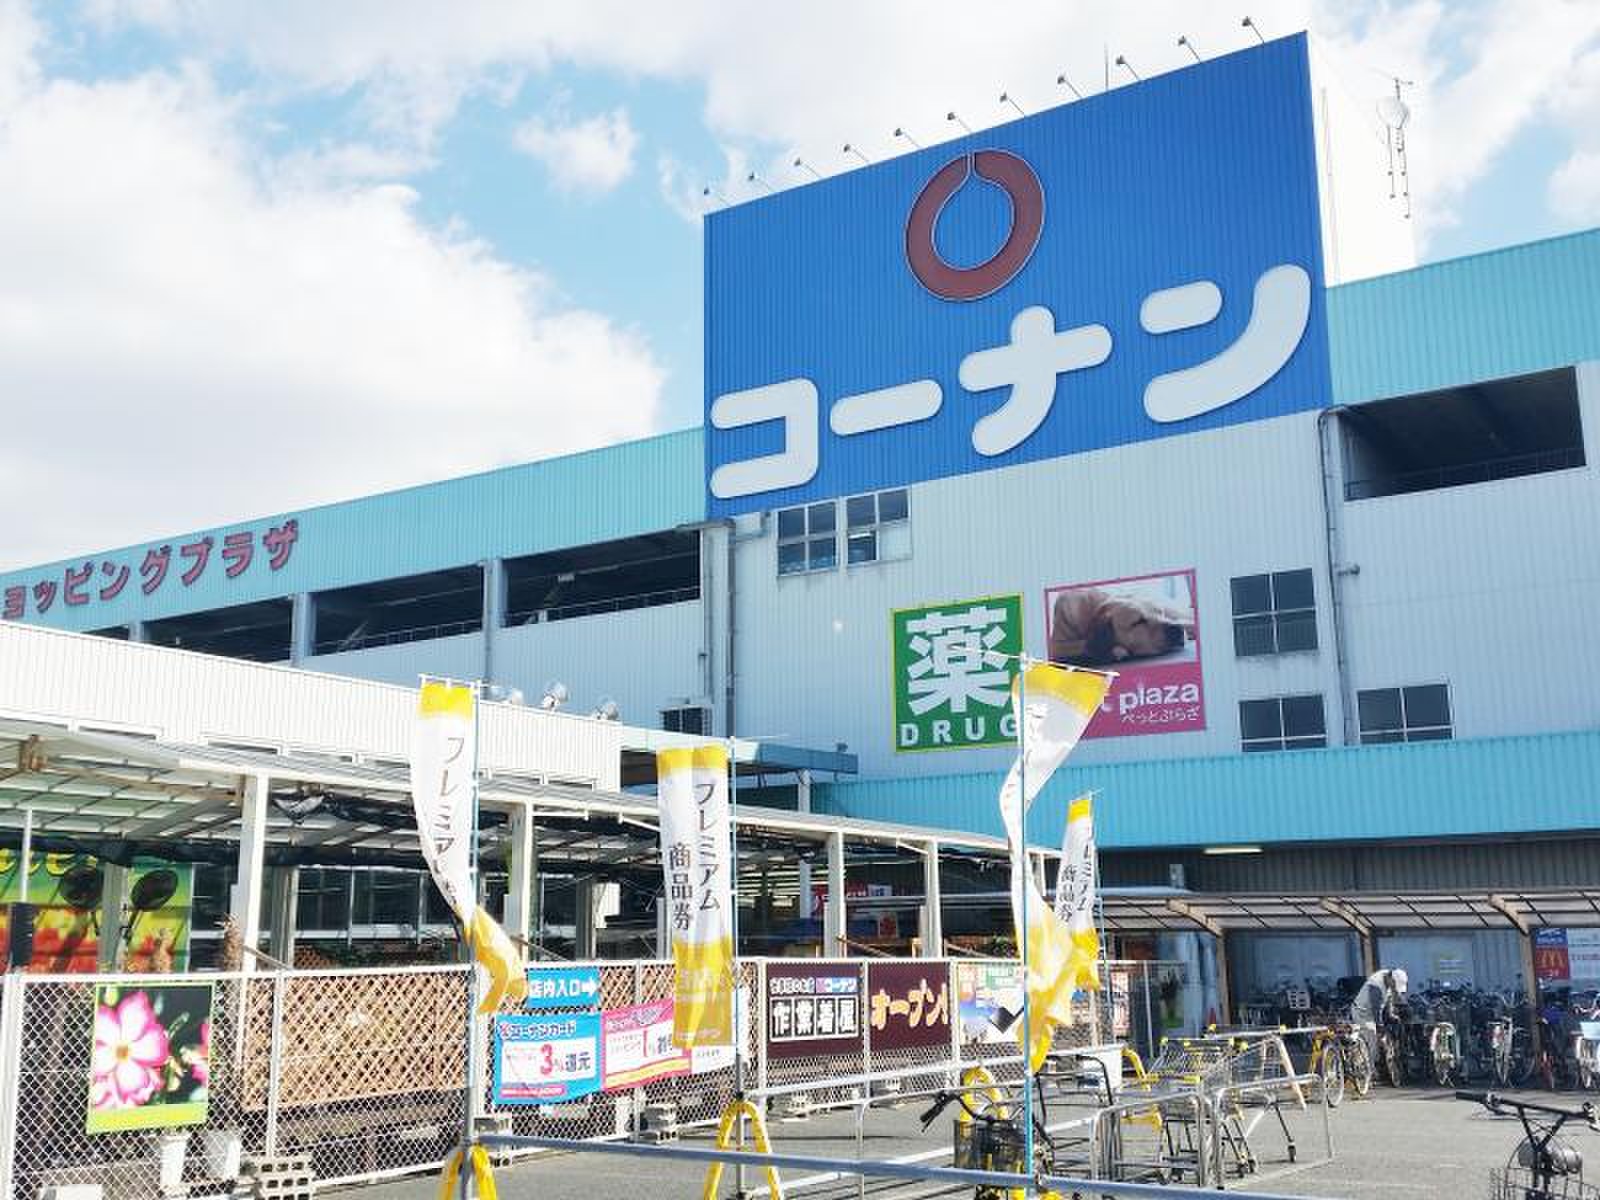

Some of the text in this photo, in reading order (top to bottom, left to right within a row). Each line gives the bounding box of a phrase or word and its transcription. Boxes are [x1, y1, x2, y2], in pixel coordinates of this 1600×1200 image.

[709, 264, 1312, 500] コーナン
[906, 605, 1010, 716] 薬
[1120, 682, 1200, 715] plaza
[899, 716, 1019, 746] DRUG
[669, 842, 693, 931] 商品券
